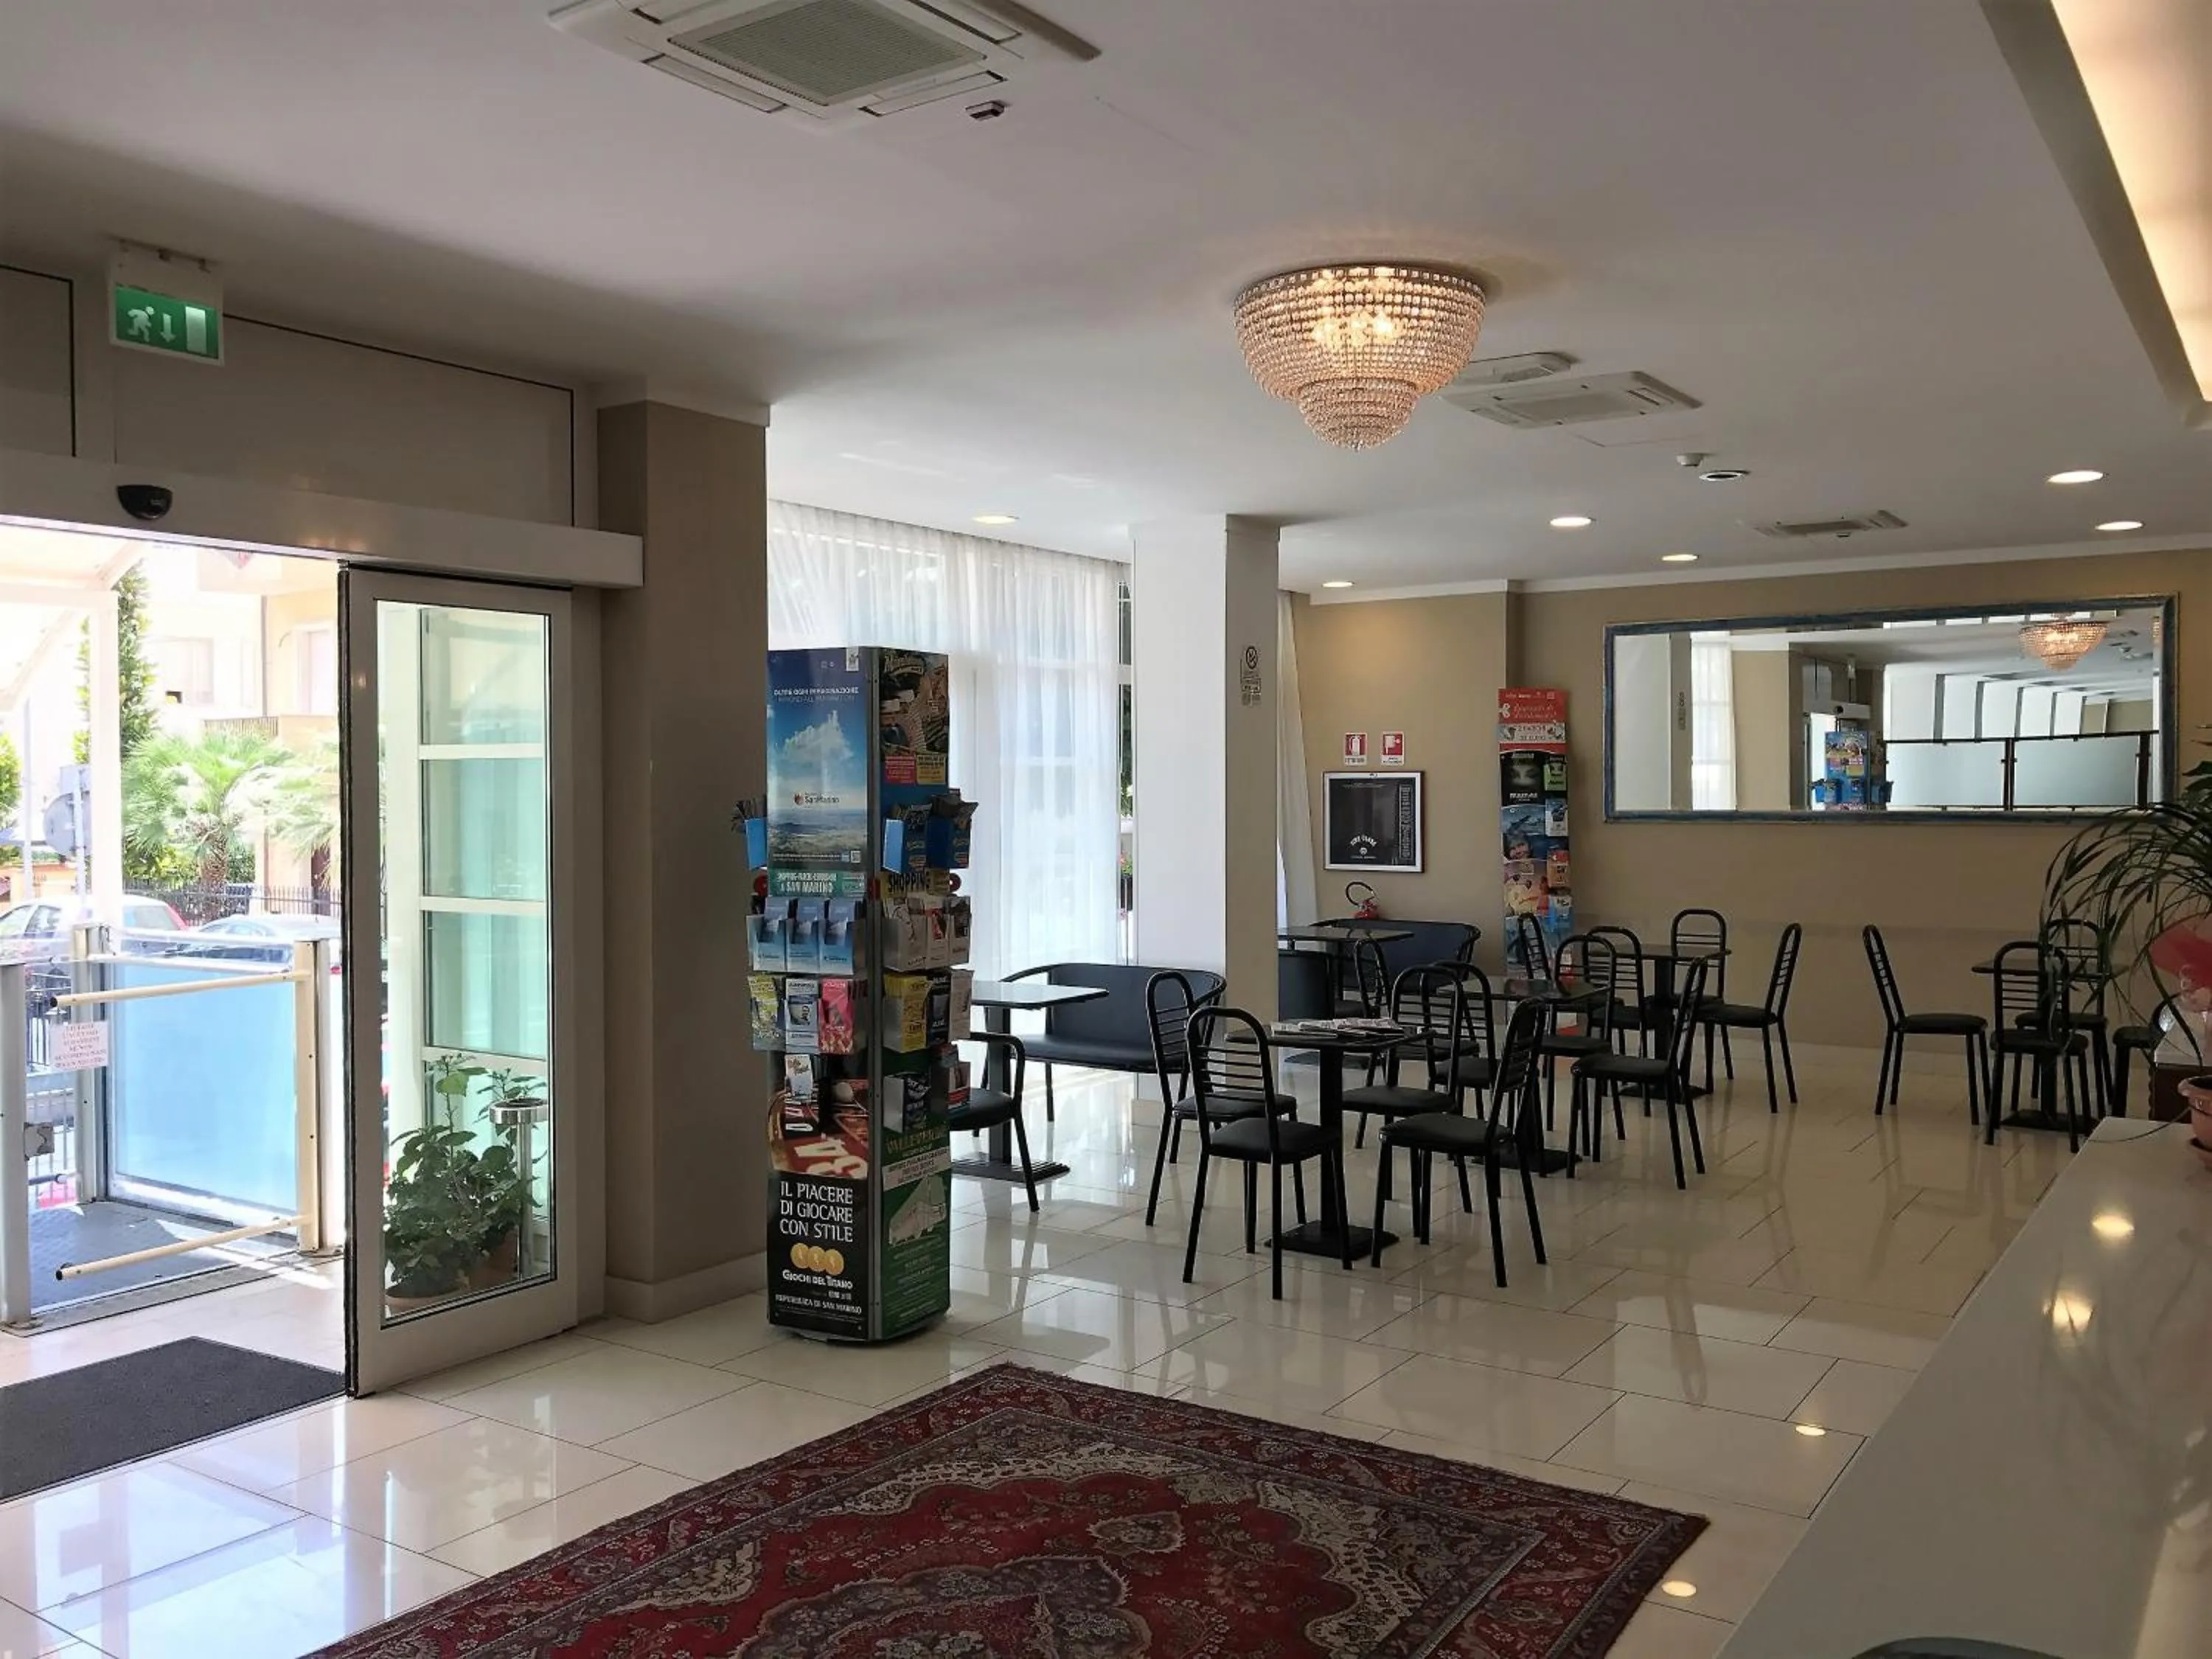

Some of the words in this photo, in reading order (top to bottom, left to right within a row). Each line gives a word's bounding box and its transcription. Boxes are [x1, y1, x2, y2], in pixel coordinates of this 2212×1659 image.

[780, 1180, 793, 1197] IL
[796, 1182, 853, 1204] PIACERE
[780, 1200, 793, 1216] DI
[797, 1201, 853, 1223] GIOCARE
[779, 1218, 809, 1237] CON
[813, 1222, 853, 1242] STILE
